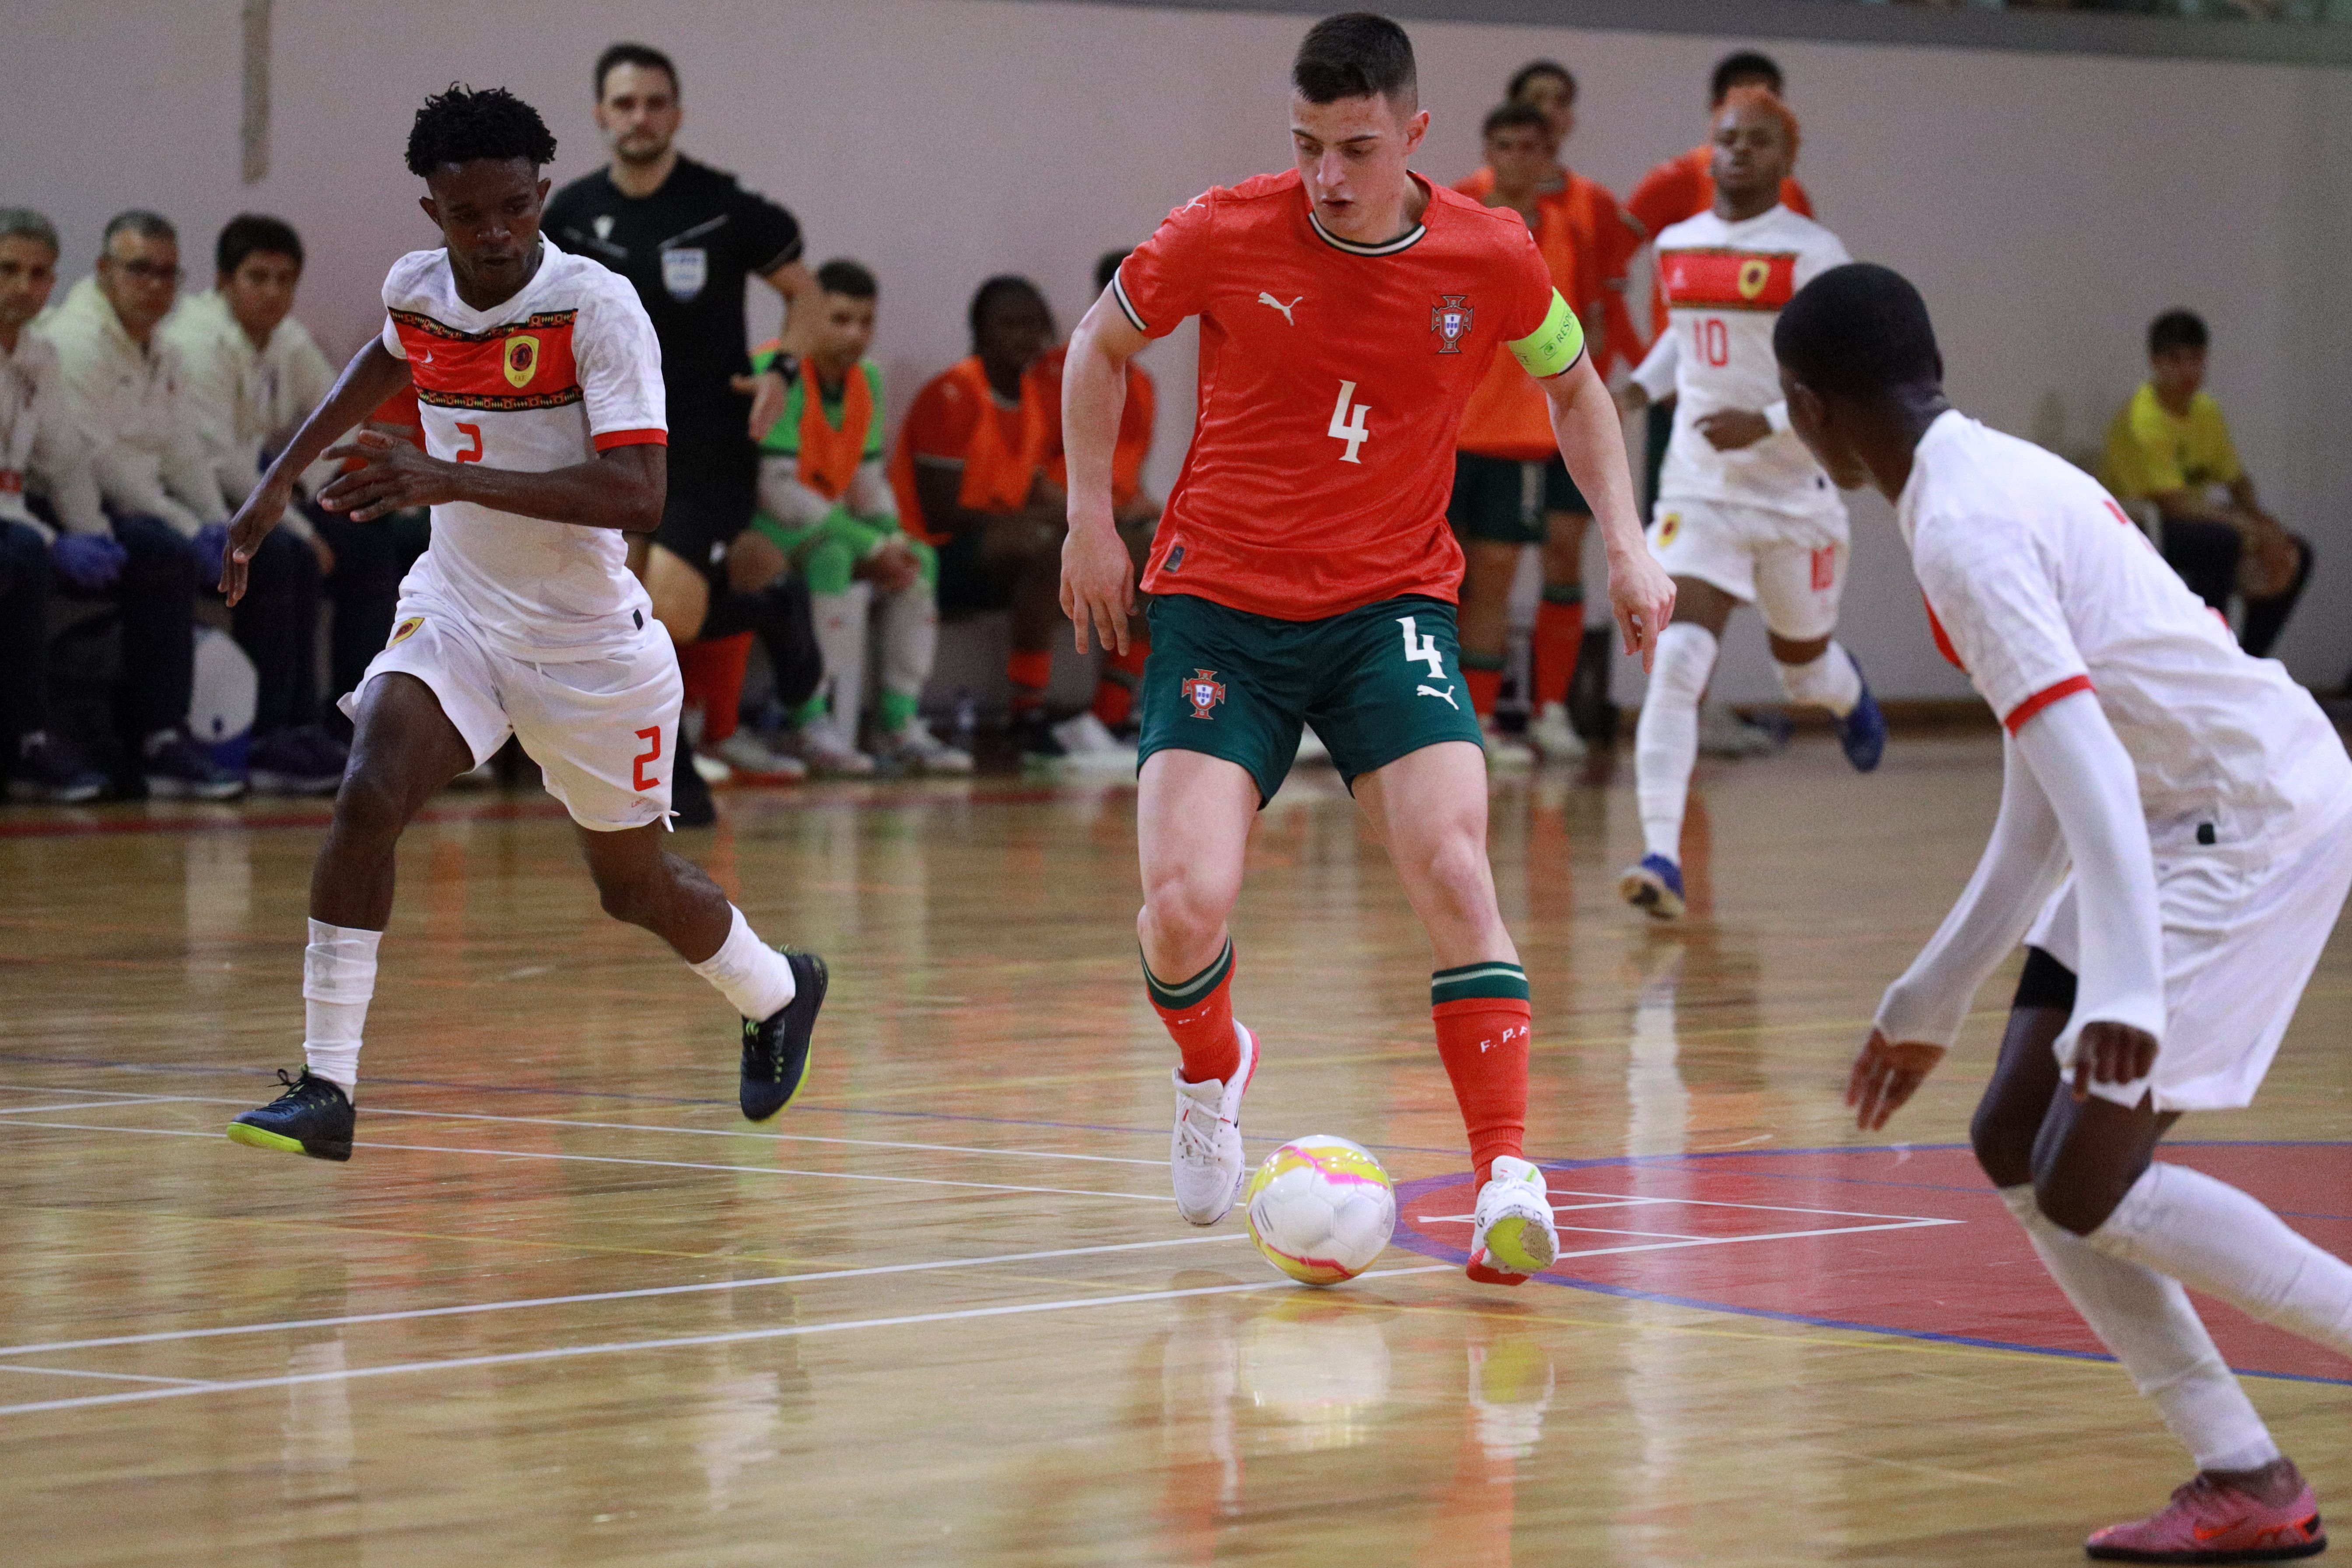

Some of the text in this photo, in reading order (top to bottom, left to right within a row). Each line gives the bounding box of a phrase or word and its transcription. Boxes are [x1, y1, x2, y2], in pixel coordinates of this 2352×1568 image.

[1693, 318, 1729, 367] 10
[455, 422, 483, 464] 2
[1327, 379, 1372, 464] 4
[1396, 616, 1447, 679] 4
[633, 726, 661, 791] 2
